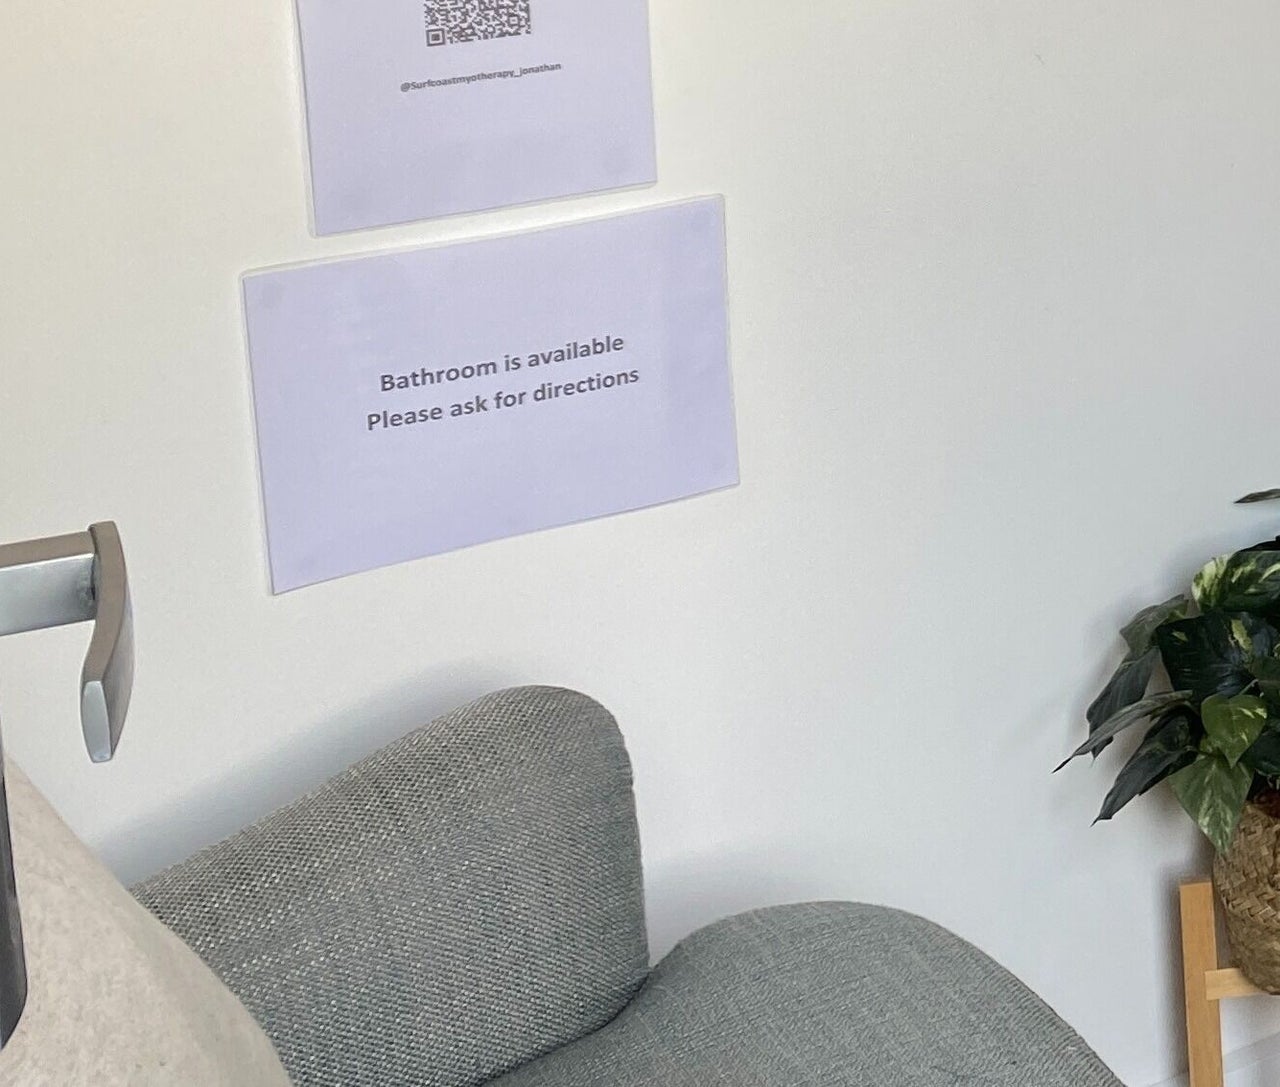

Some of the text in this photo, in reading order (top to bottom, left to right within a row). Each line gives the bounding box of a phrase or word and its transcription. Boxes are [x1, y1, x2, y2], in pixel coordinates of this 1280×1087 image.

[380, 335, 624, 392] Bathroom is available
[367, 368, 640, 431] Please ask for directions
